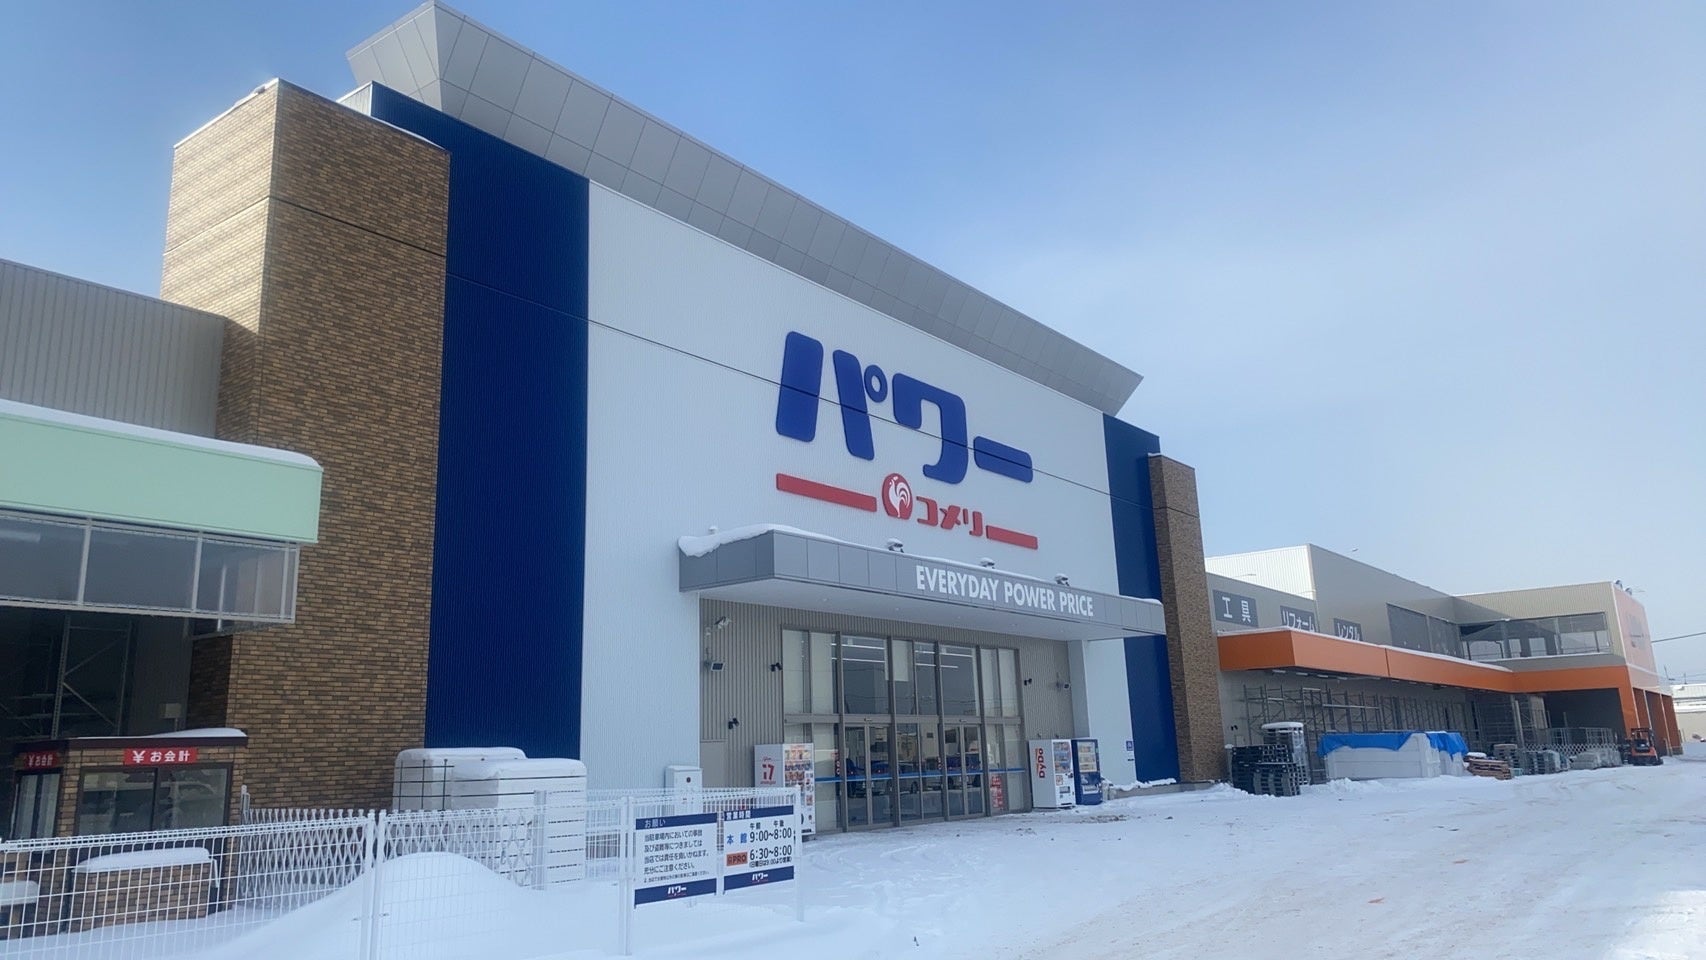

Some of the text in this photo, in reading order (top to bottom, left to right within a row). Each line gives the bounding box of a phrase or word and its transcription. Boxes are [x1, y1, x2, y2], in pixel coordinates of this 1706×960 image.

[775, 331, 1033, 484] パワー
[916, 495, 983, 537] コメリ
[915, 565, 1094, 617] EVERYDAY POWER PRICE
[1222, 596, 1251, 623] 工具
[1282, 610, 1316, 633] リフォーム
